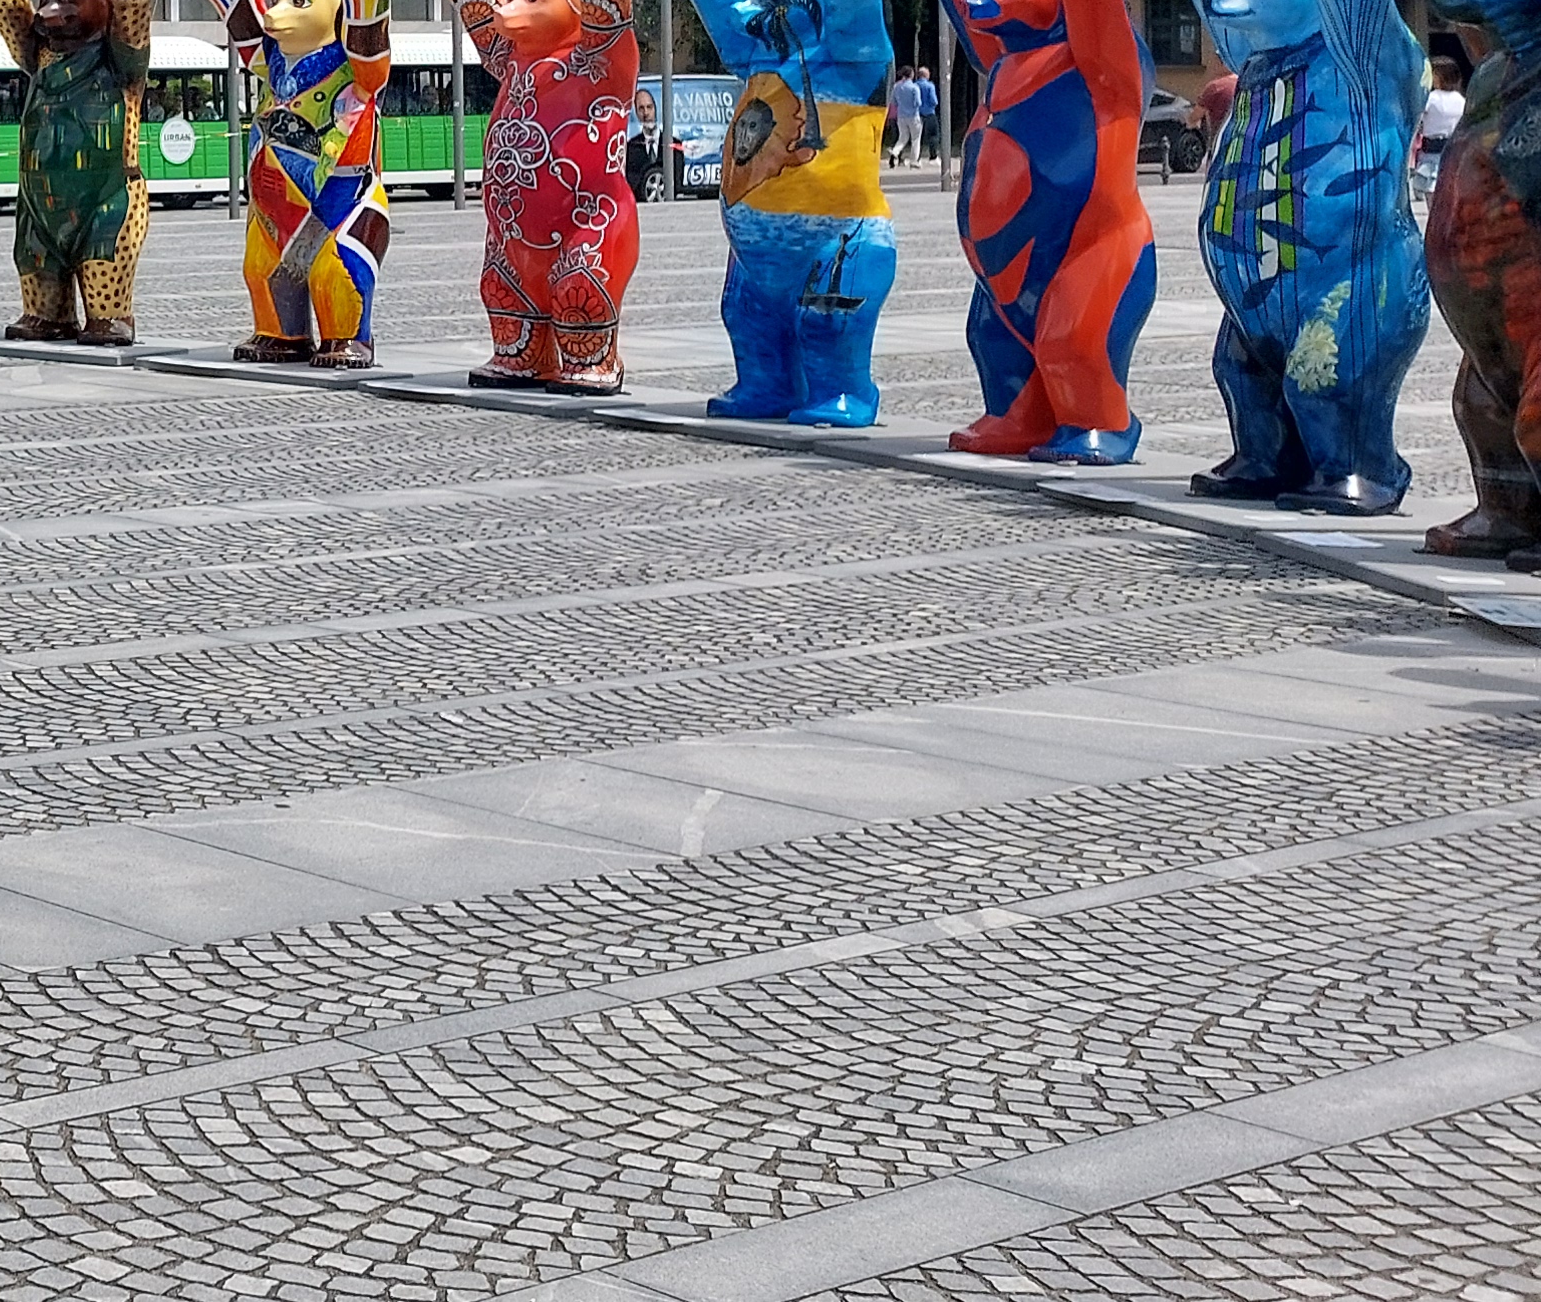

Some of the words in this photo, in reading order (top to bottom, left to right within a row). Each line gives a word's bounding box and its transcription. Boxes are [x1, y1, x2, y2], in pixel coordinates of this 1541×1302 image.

[684, 91, 733, 107] VARNO
[673, 107, 735, 124] LOVENIJO
[164, 133, 191, 142] URBAN
[692, 167, 702, 182] 5
